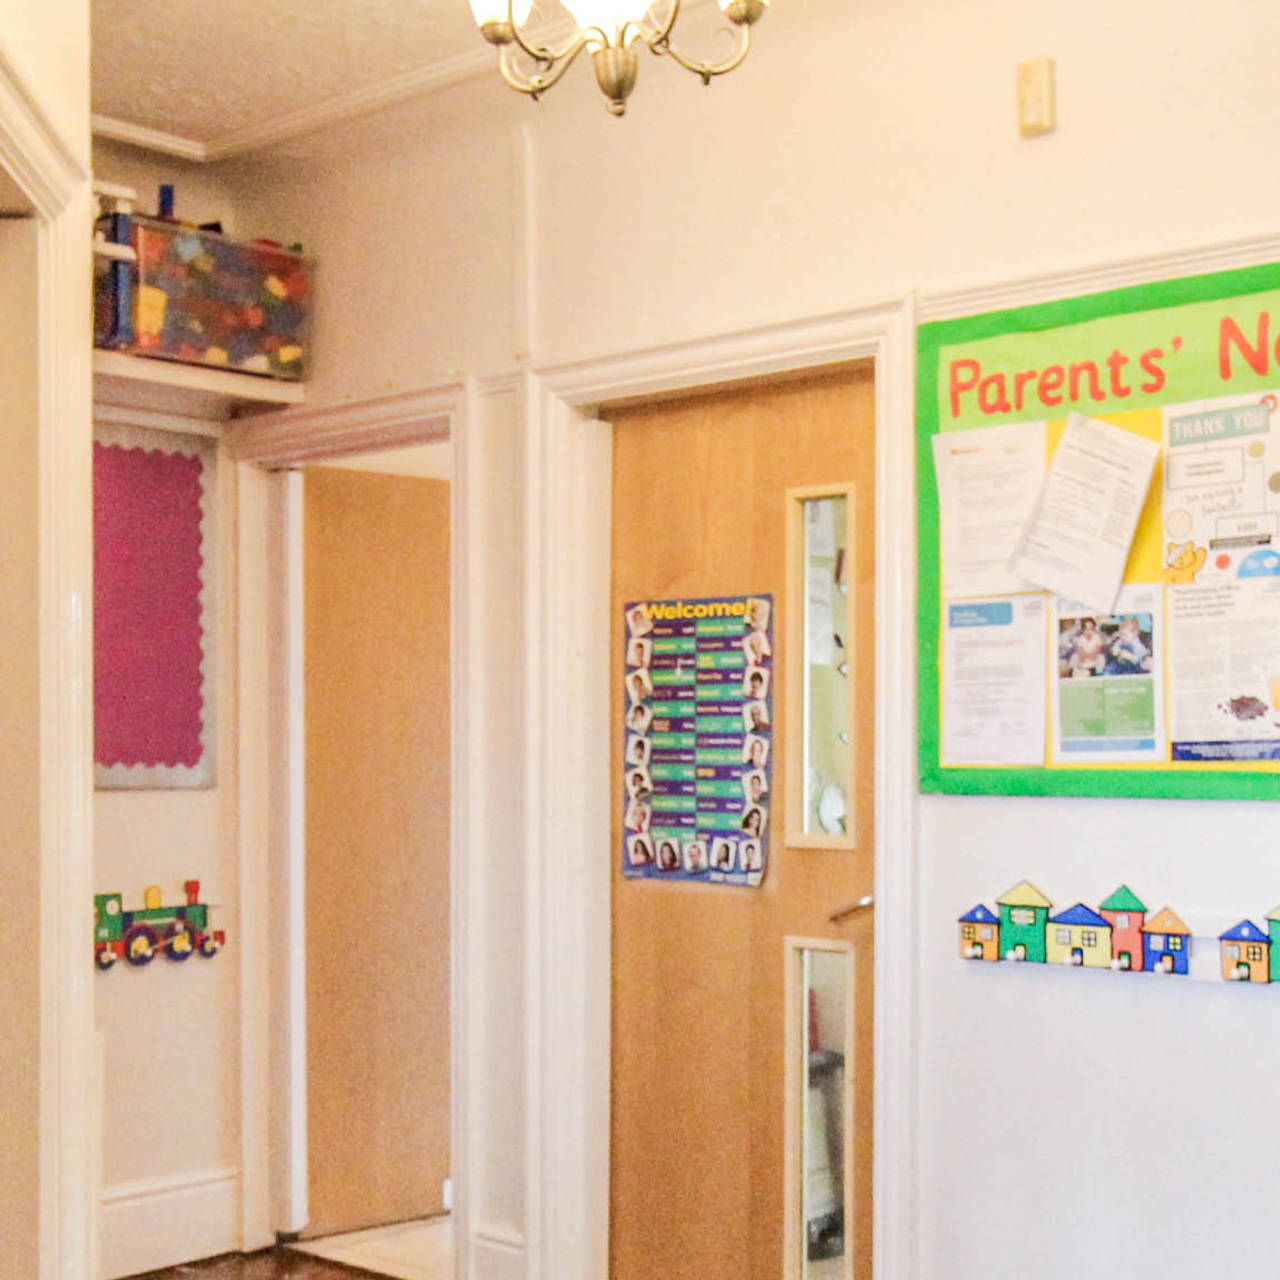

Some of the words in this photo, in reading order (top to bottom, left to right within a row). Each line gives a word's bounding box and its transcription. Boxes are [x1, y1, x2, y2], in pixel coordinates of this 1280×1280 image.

[949, 338, 1184, 419] Parents'
[1173, 416, 1225, 440] THANK
[1233, 408, 1266, 430] YOU
